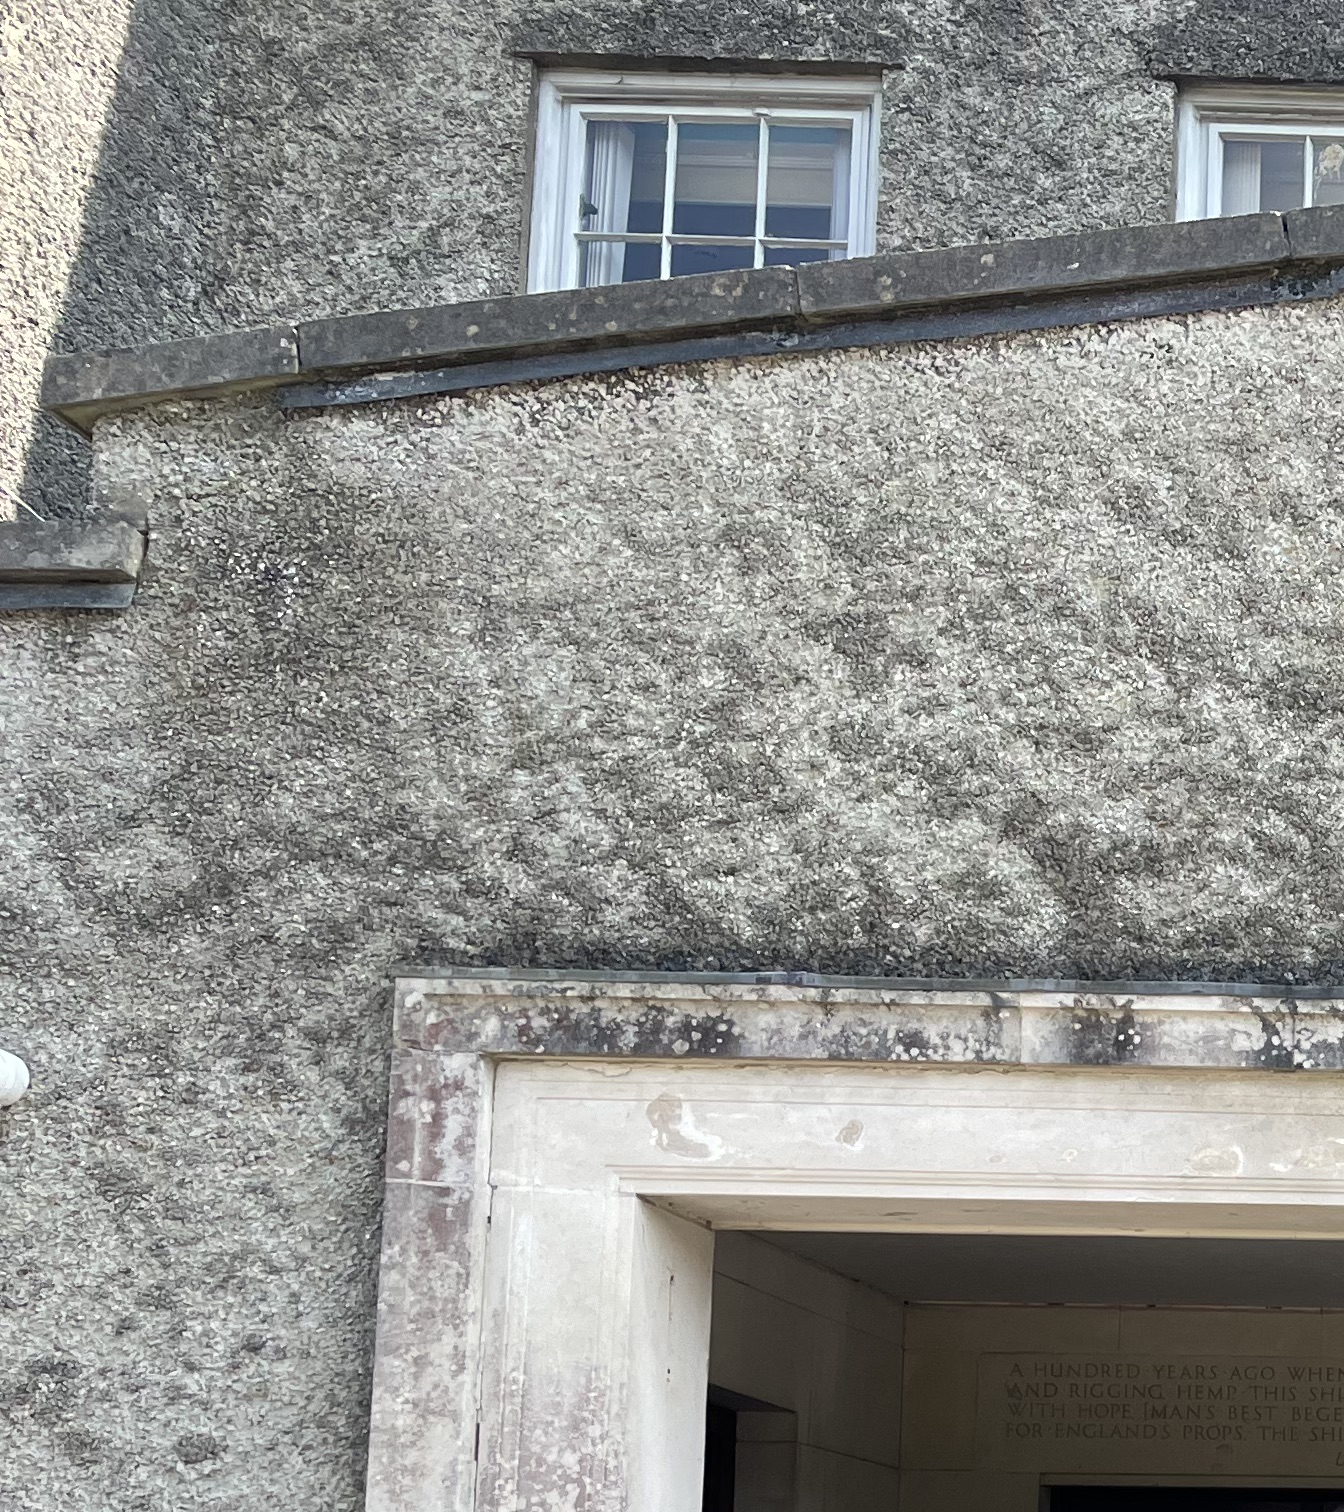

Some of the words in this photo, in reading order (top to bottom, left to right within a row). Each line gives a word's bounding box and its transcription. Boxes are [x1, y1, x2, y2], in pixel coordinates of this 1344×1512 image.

[1009, 1363, 1025, 1378] A
[1034, 1363, 1141, 1379] HUNDRED
[1152, 1364, 1218, 1380] YEARS
[1228, 1365, 1276, 1381] AGO
[1008, 1382, 1058, 1399] AND
[1068, 1383, 1163, 1400] RIGGING
[1247, 1385, 1297, 1402] THIS
[1007, 1402, 1066, 1418] WITH
[1228, 1404, 1277, 1421] BEST
[1006, 1422, 1044, 1438] FOR
[1256, 1425, 1298, 1442] THE
